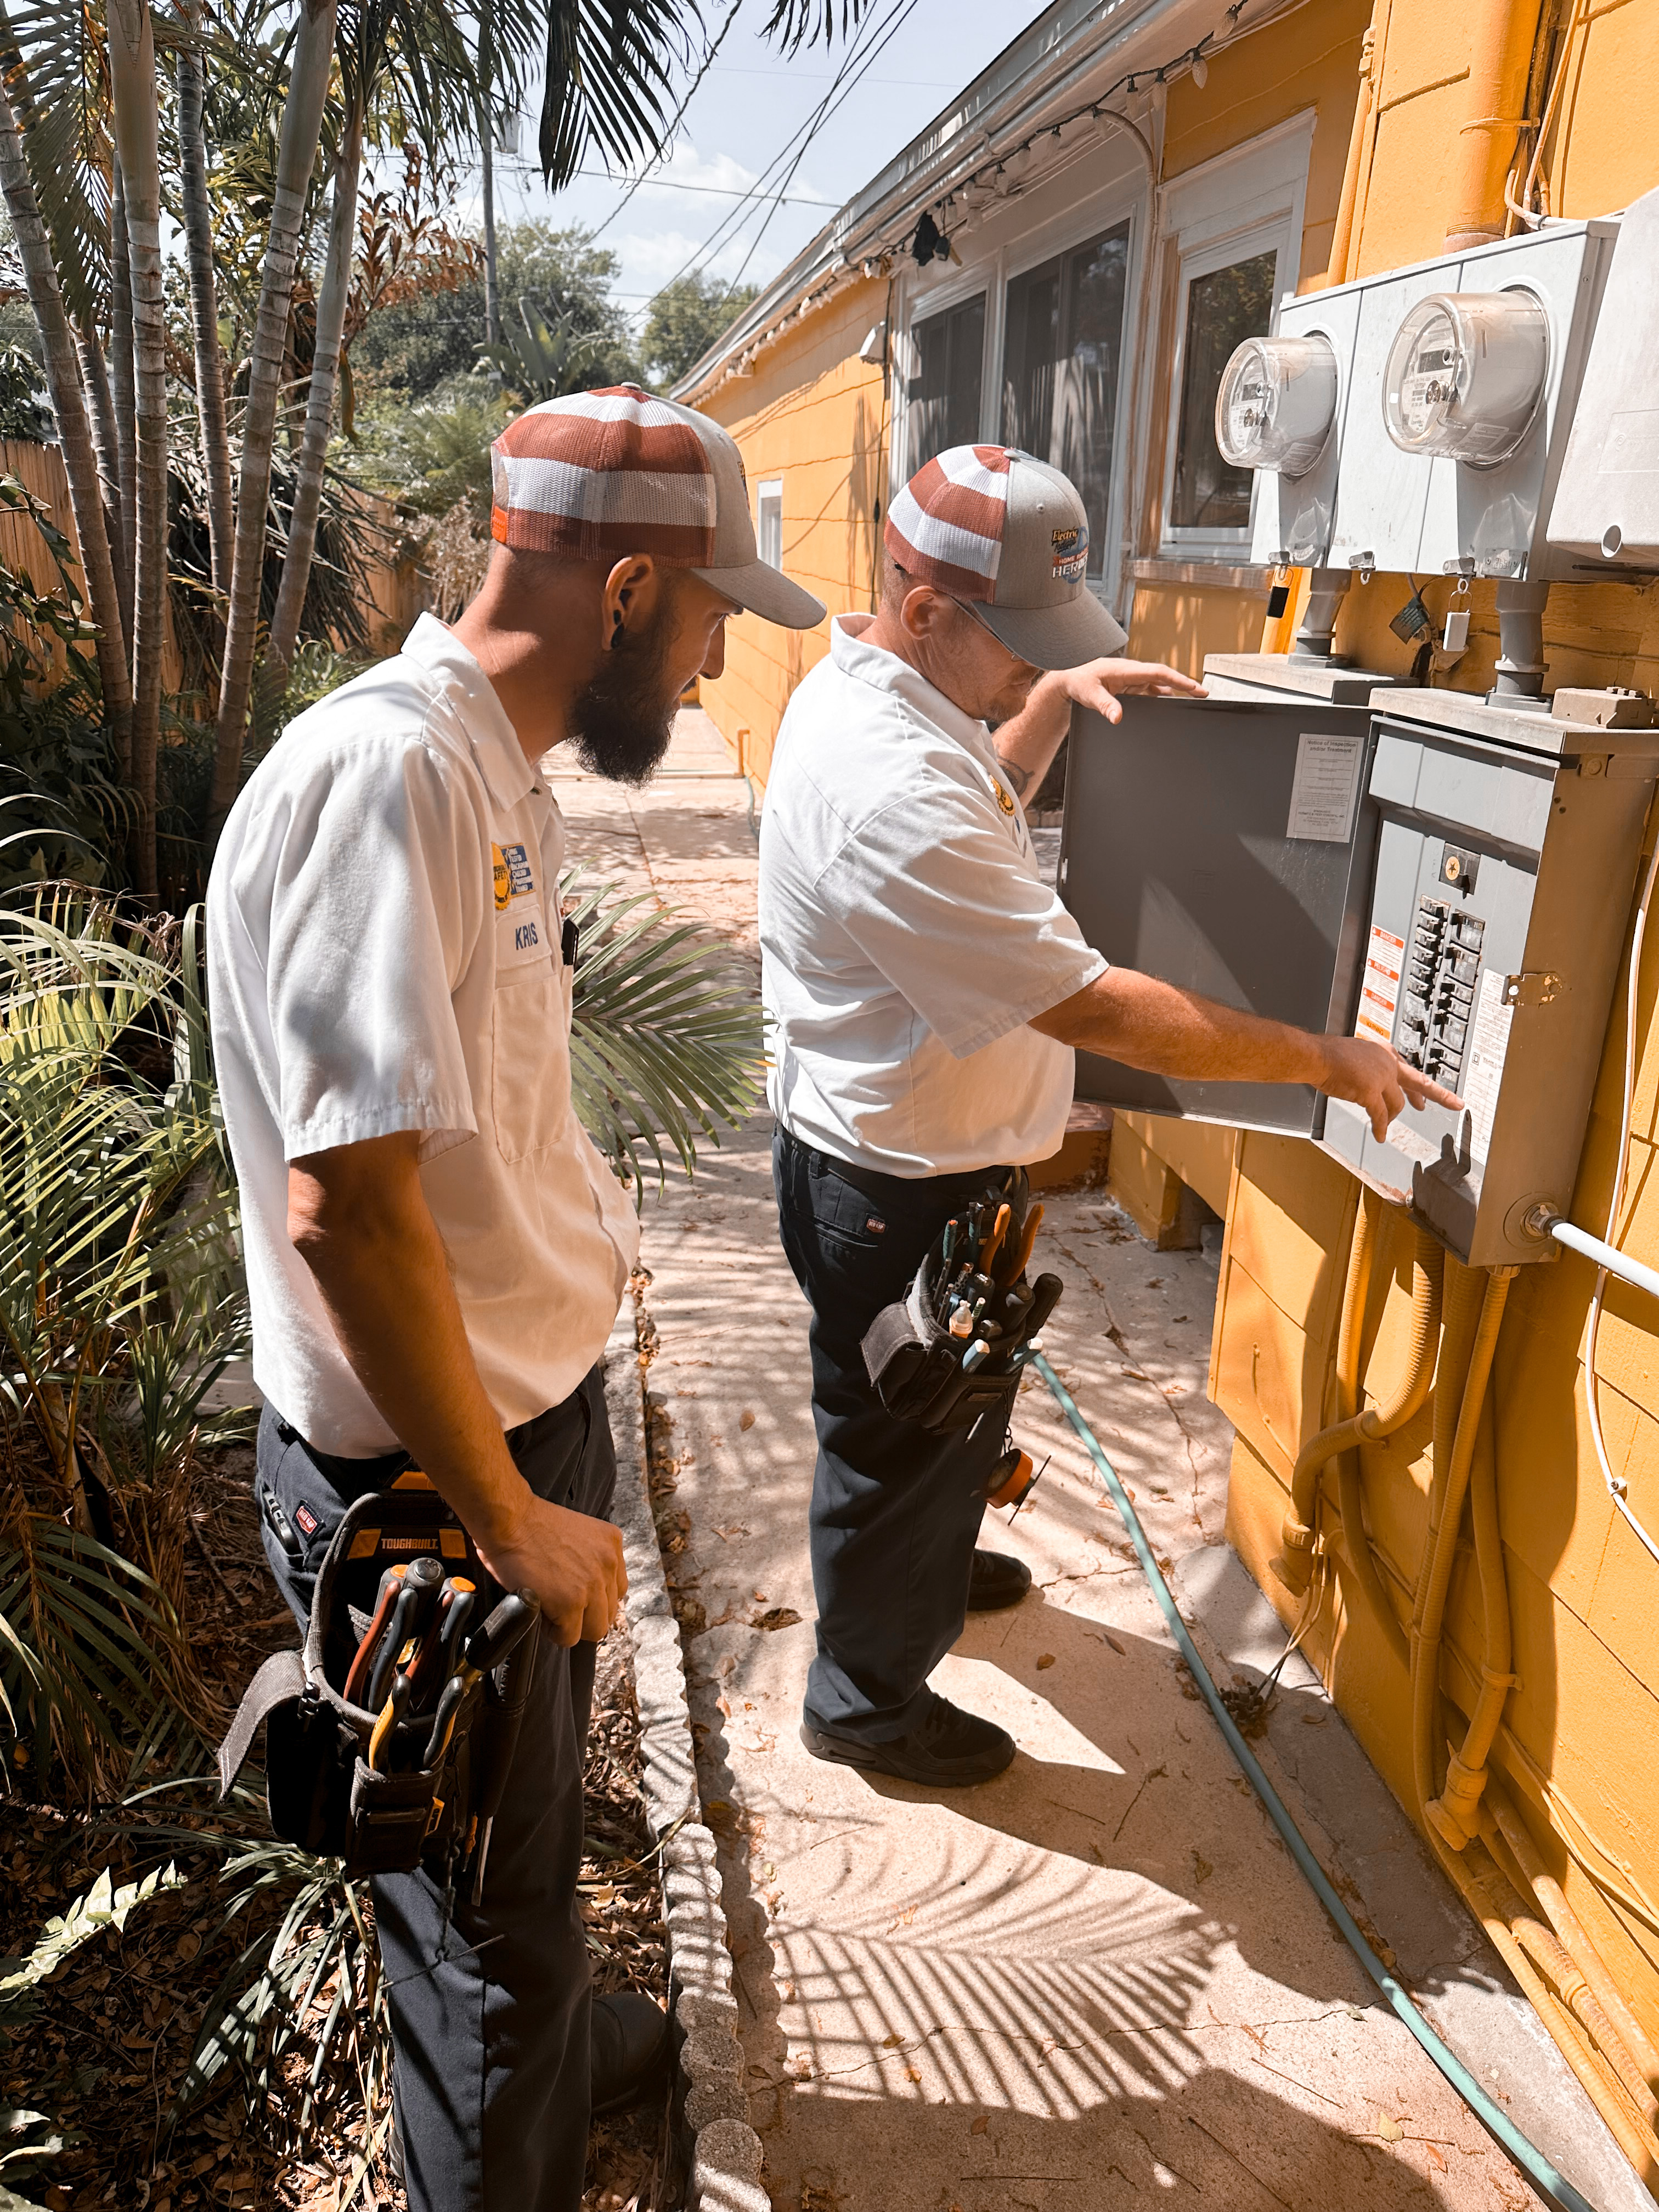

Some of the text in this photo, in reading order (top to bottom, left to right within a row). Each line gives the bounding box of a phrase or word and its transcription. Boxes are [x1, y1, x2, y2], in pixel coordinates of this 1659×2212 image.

[1052, 527, 1078, 541] Electric
[1059, 555, 1075, 564] HOME
[516, 922, 538, 950] KRIS
[1380, 931, 1396, 944] DANGER
[1374, 962, 1391, 976] PELIGRO
[1371, 993, 1387, 1006] DANGER
[1366, 1020, 1384, 1036] WARNING
[299, 1509, 308, 1521] RED
[306, 1517, 314, 1528] KAP
